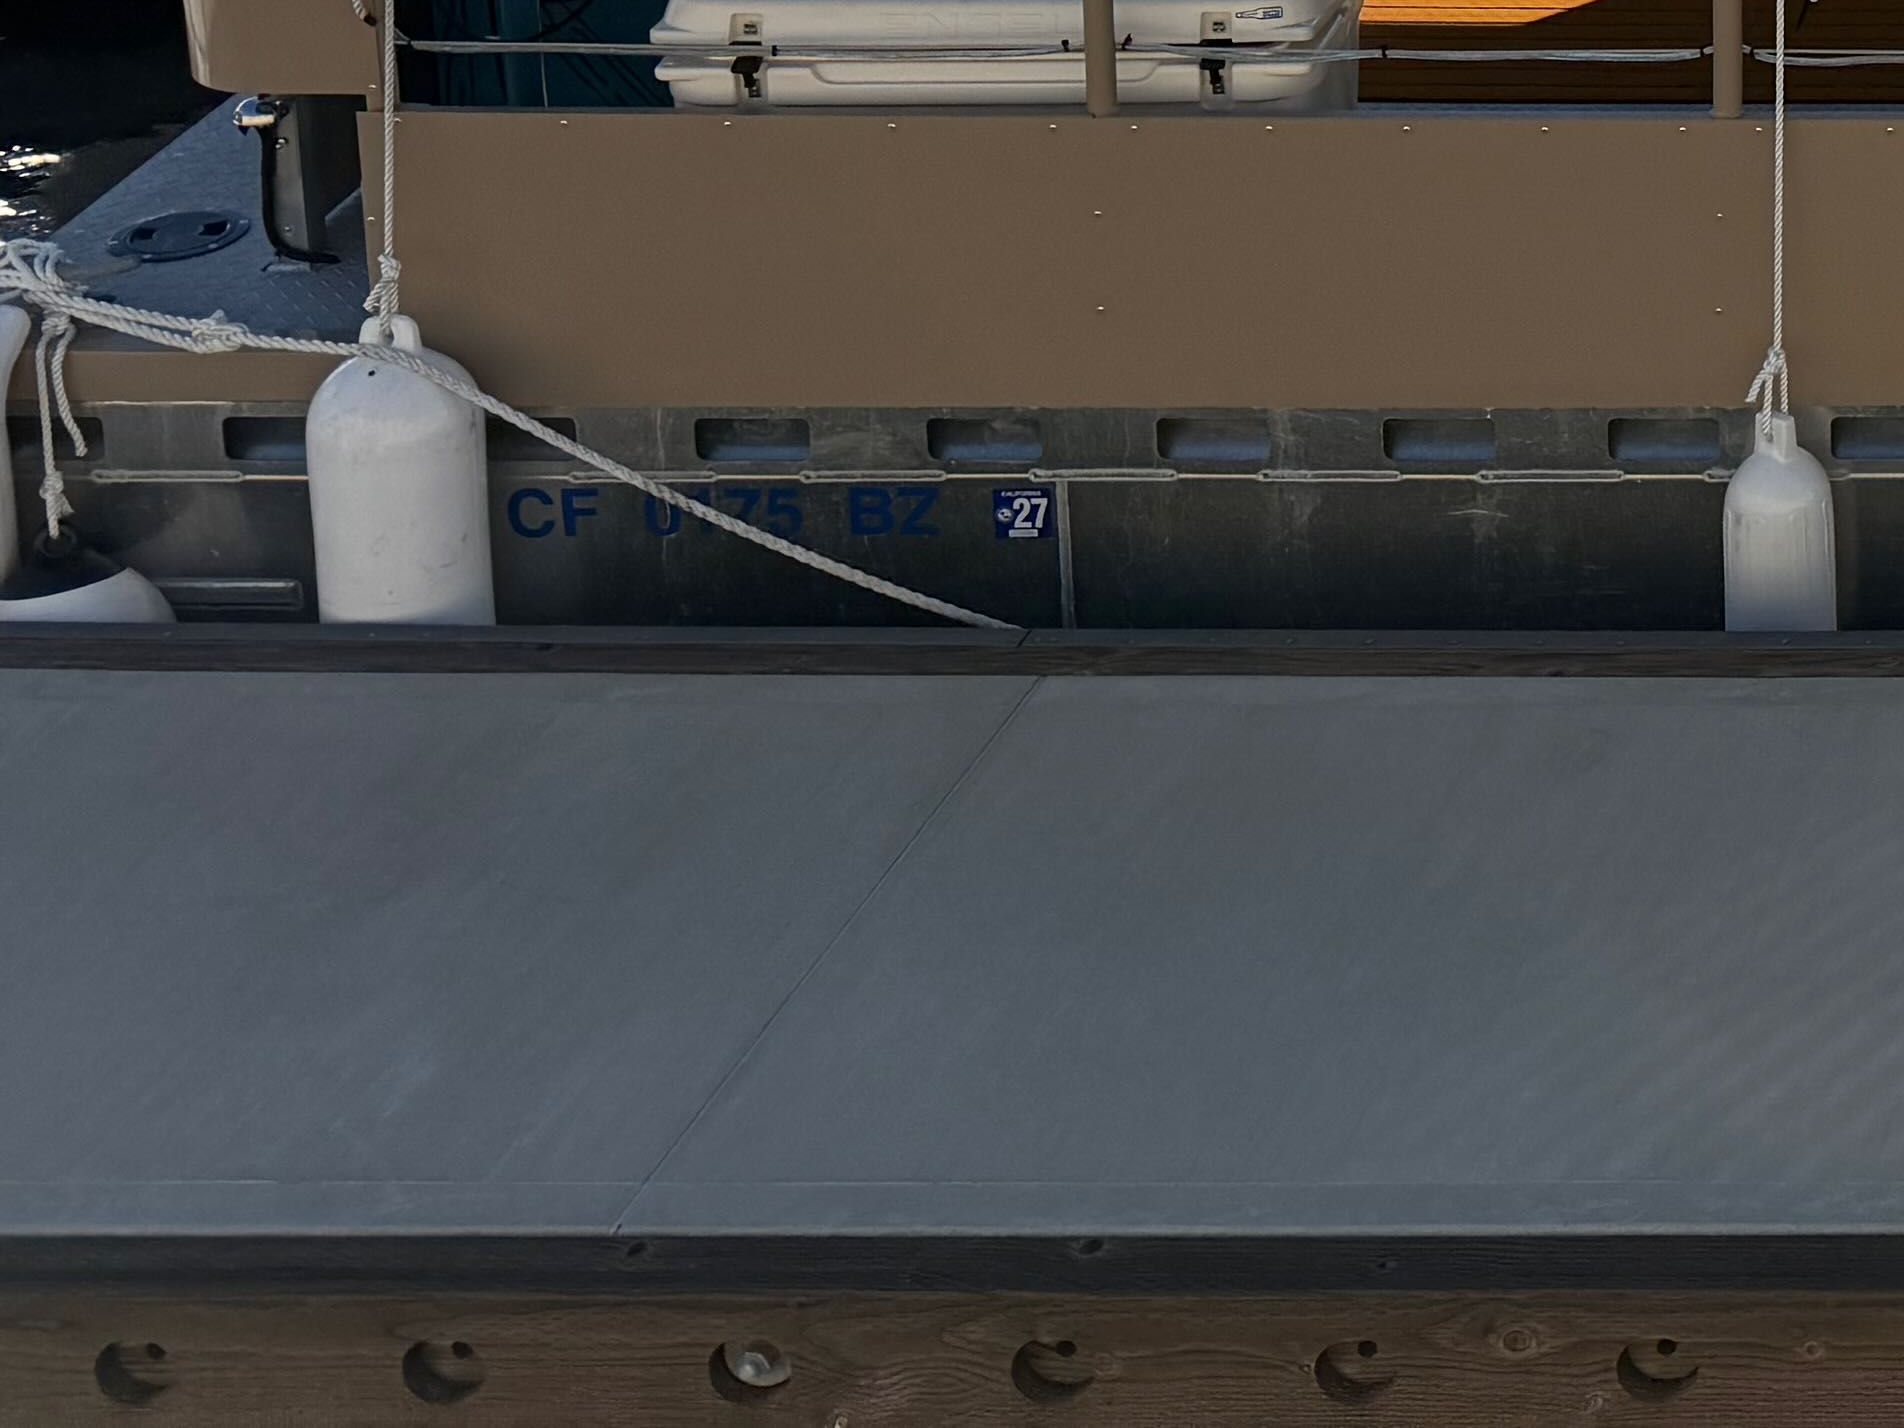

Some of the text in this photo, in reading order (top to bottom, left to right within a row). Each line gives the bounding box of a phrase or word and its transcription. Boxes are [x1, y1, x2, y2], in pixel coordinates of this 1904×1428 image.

[507, 487, 600, 538] CF
[847, 486, 941, 537] BZ
[1013, 498, 1049, 529] 27
